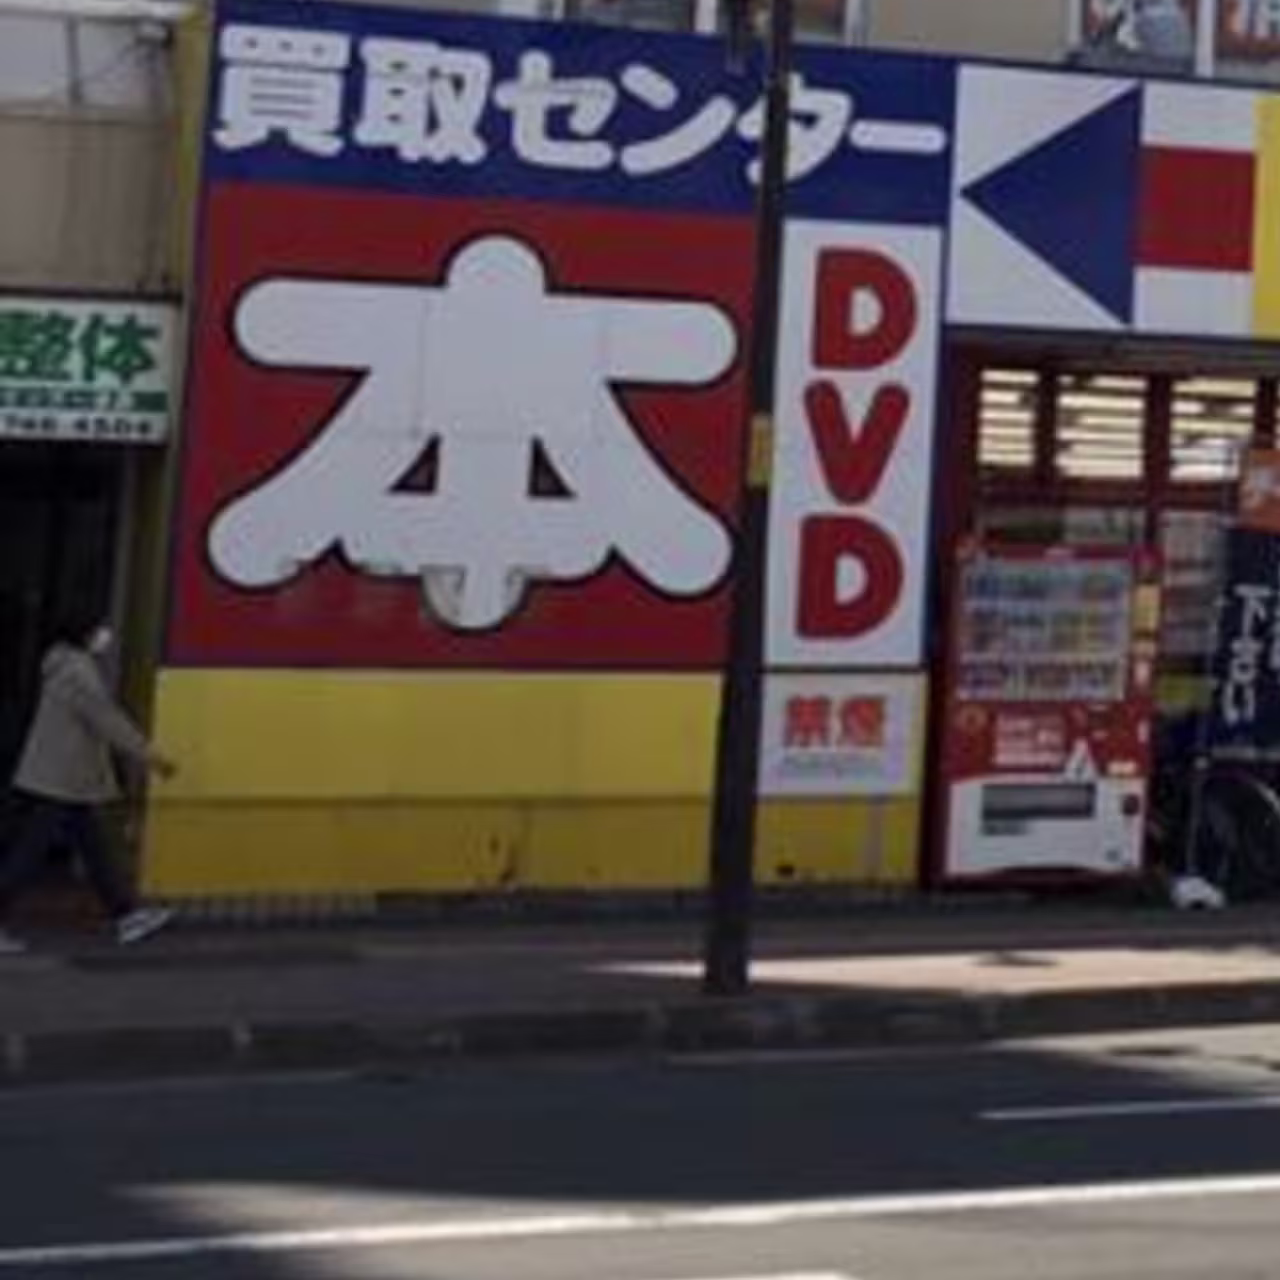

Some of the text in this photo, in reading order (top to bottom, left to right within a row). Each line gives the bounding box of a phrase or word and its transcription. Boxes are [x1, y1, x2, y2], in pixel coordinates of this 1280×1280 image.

[212, 24, 947, 183] 買取センター
[207, 232, 738, 629] 本
[794, 246, 918, 638] DVD
